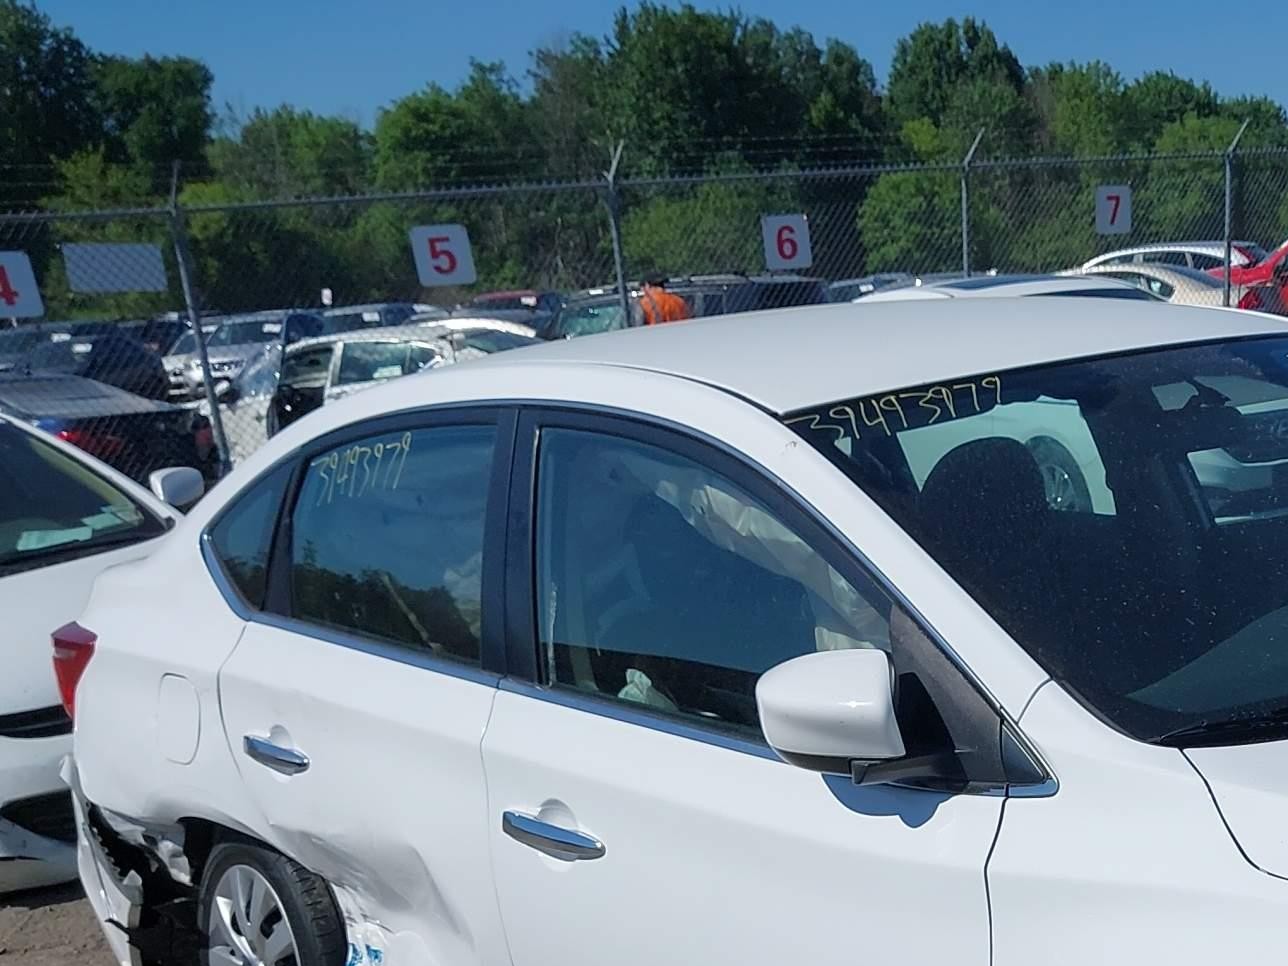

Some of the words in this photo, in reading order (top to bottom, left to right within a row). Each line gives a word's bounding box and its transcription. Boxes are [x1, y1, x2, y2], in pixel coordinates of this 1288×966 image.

[1106, 195, 1121, 225] 7
[427, 236, 457, 274] 5
[776, 225, 798, 260] 6
[783, 375, 1001, 440] 39493979
[311, 431, 412, 507] 39493979
